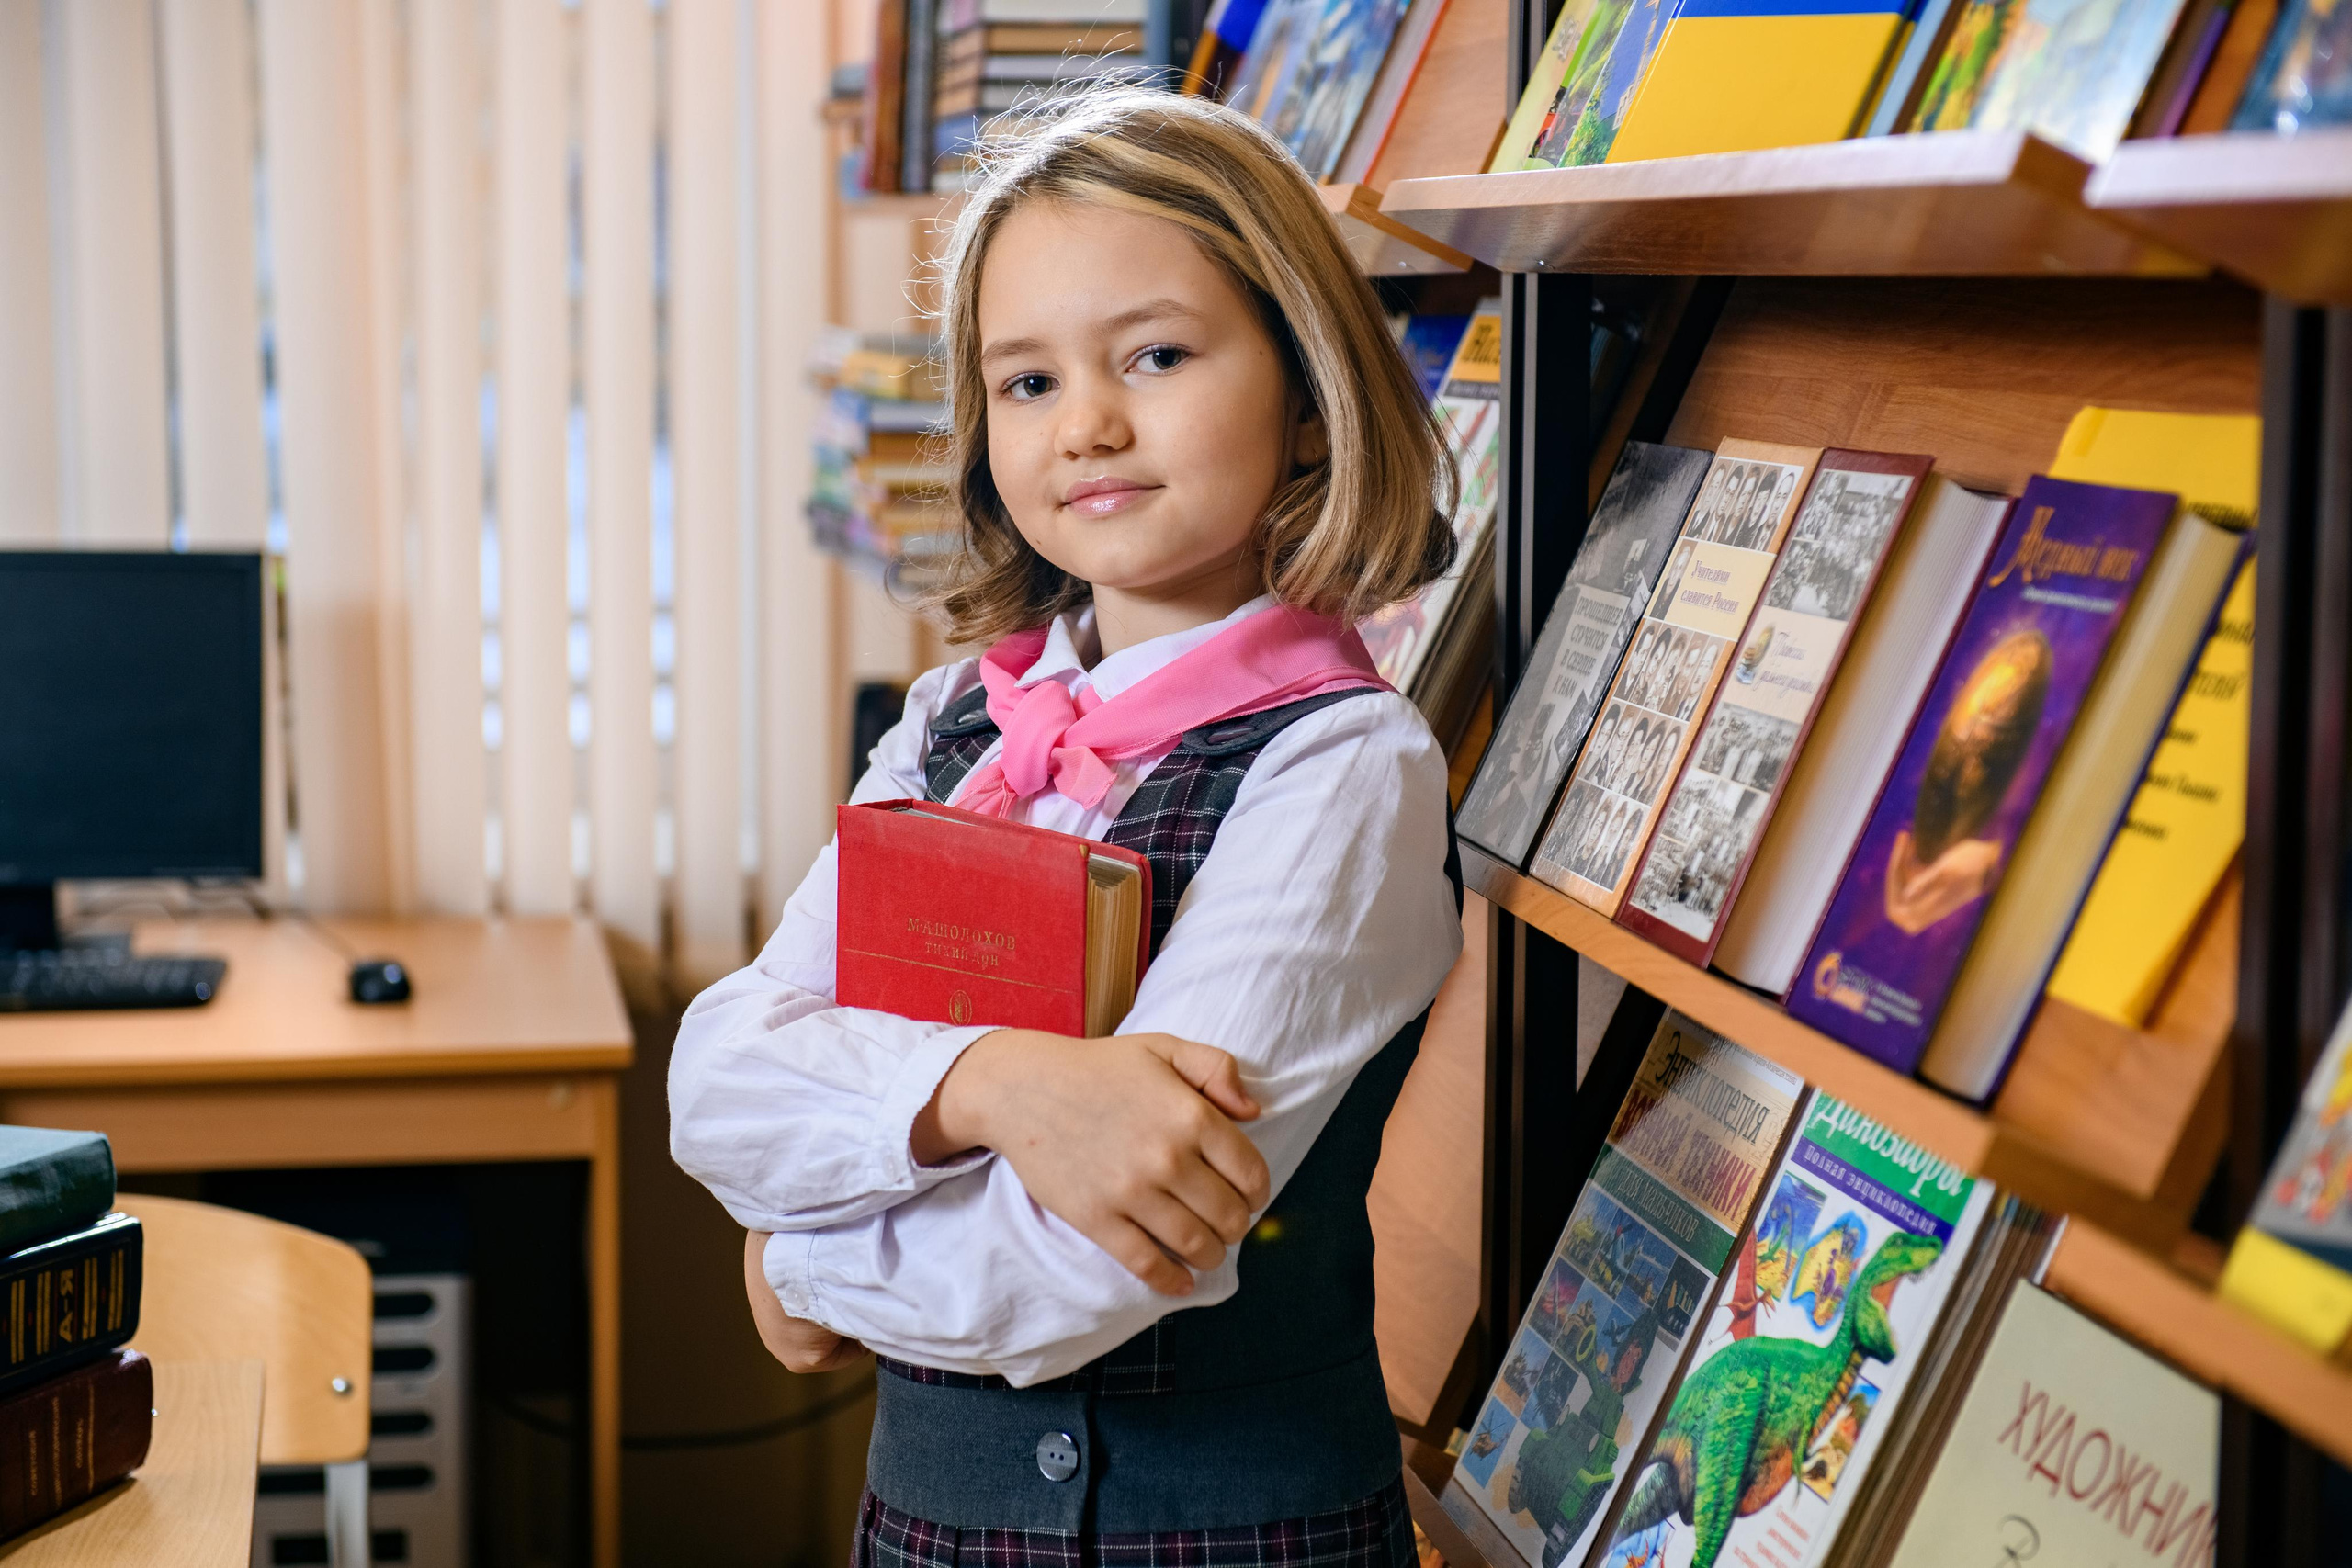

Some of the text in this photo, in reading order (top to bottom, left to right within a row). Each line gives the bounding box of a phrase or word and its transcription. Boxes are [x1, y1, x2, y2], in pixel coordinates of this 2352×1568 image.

[1691, 559, 1731, 583] Учителями
[1574, 595, 1624, 627] ПРОШЕДШЕЕ
[1680, 589, 1740, 614] славится Россия
[1570, 623, 1610, 652] СТУЧИТСЯ
[1566, 650, 1598, 677] СЕРДЦЕ
[1558, 676, 1579, 699] НАМ
[924, 942, 1000, 967] ТИХИЙ ДОН
